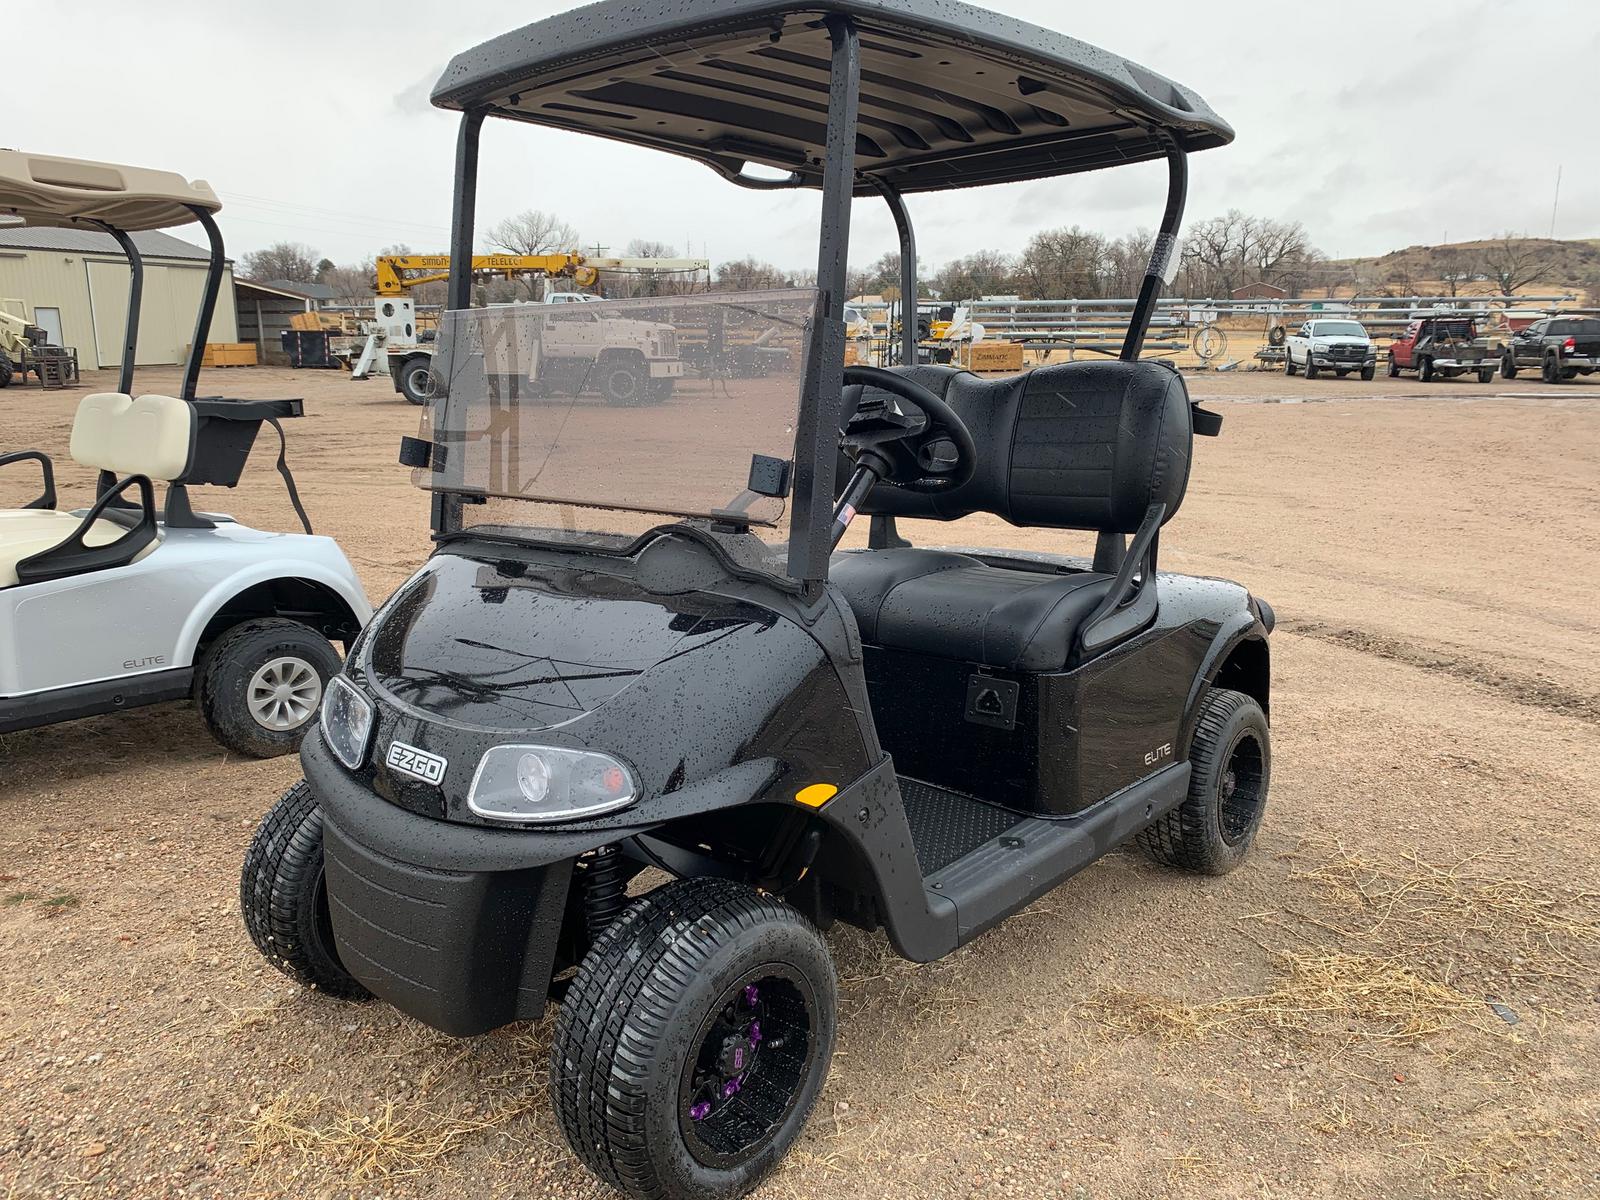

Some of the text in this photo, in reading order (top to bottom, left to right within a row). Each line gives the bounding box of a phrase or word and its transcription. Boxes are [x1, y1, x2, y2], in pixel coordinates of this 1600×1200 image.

[487, 257, 523, 266] TELELECT
[123, 656, 165, 669] ELITE
[1144, 743, 1171, 765] ELITE
[388, 746, 442, 781] EZGO
